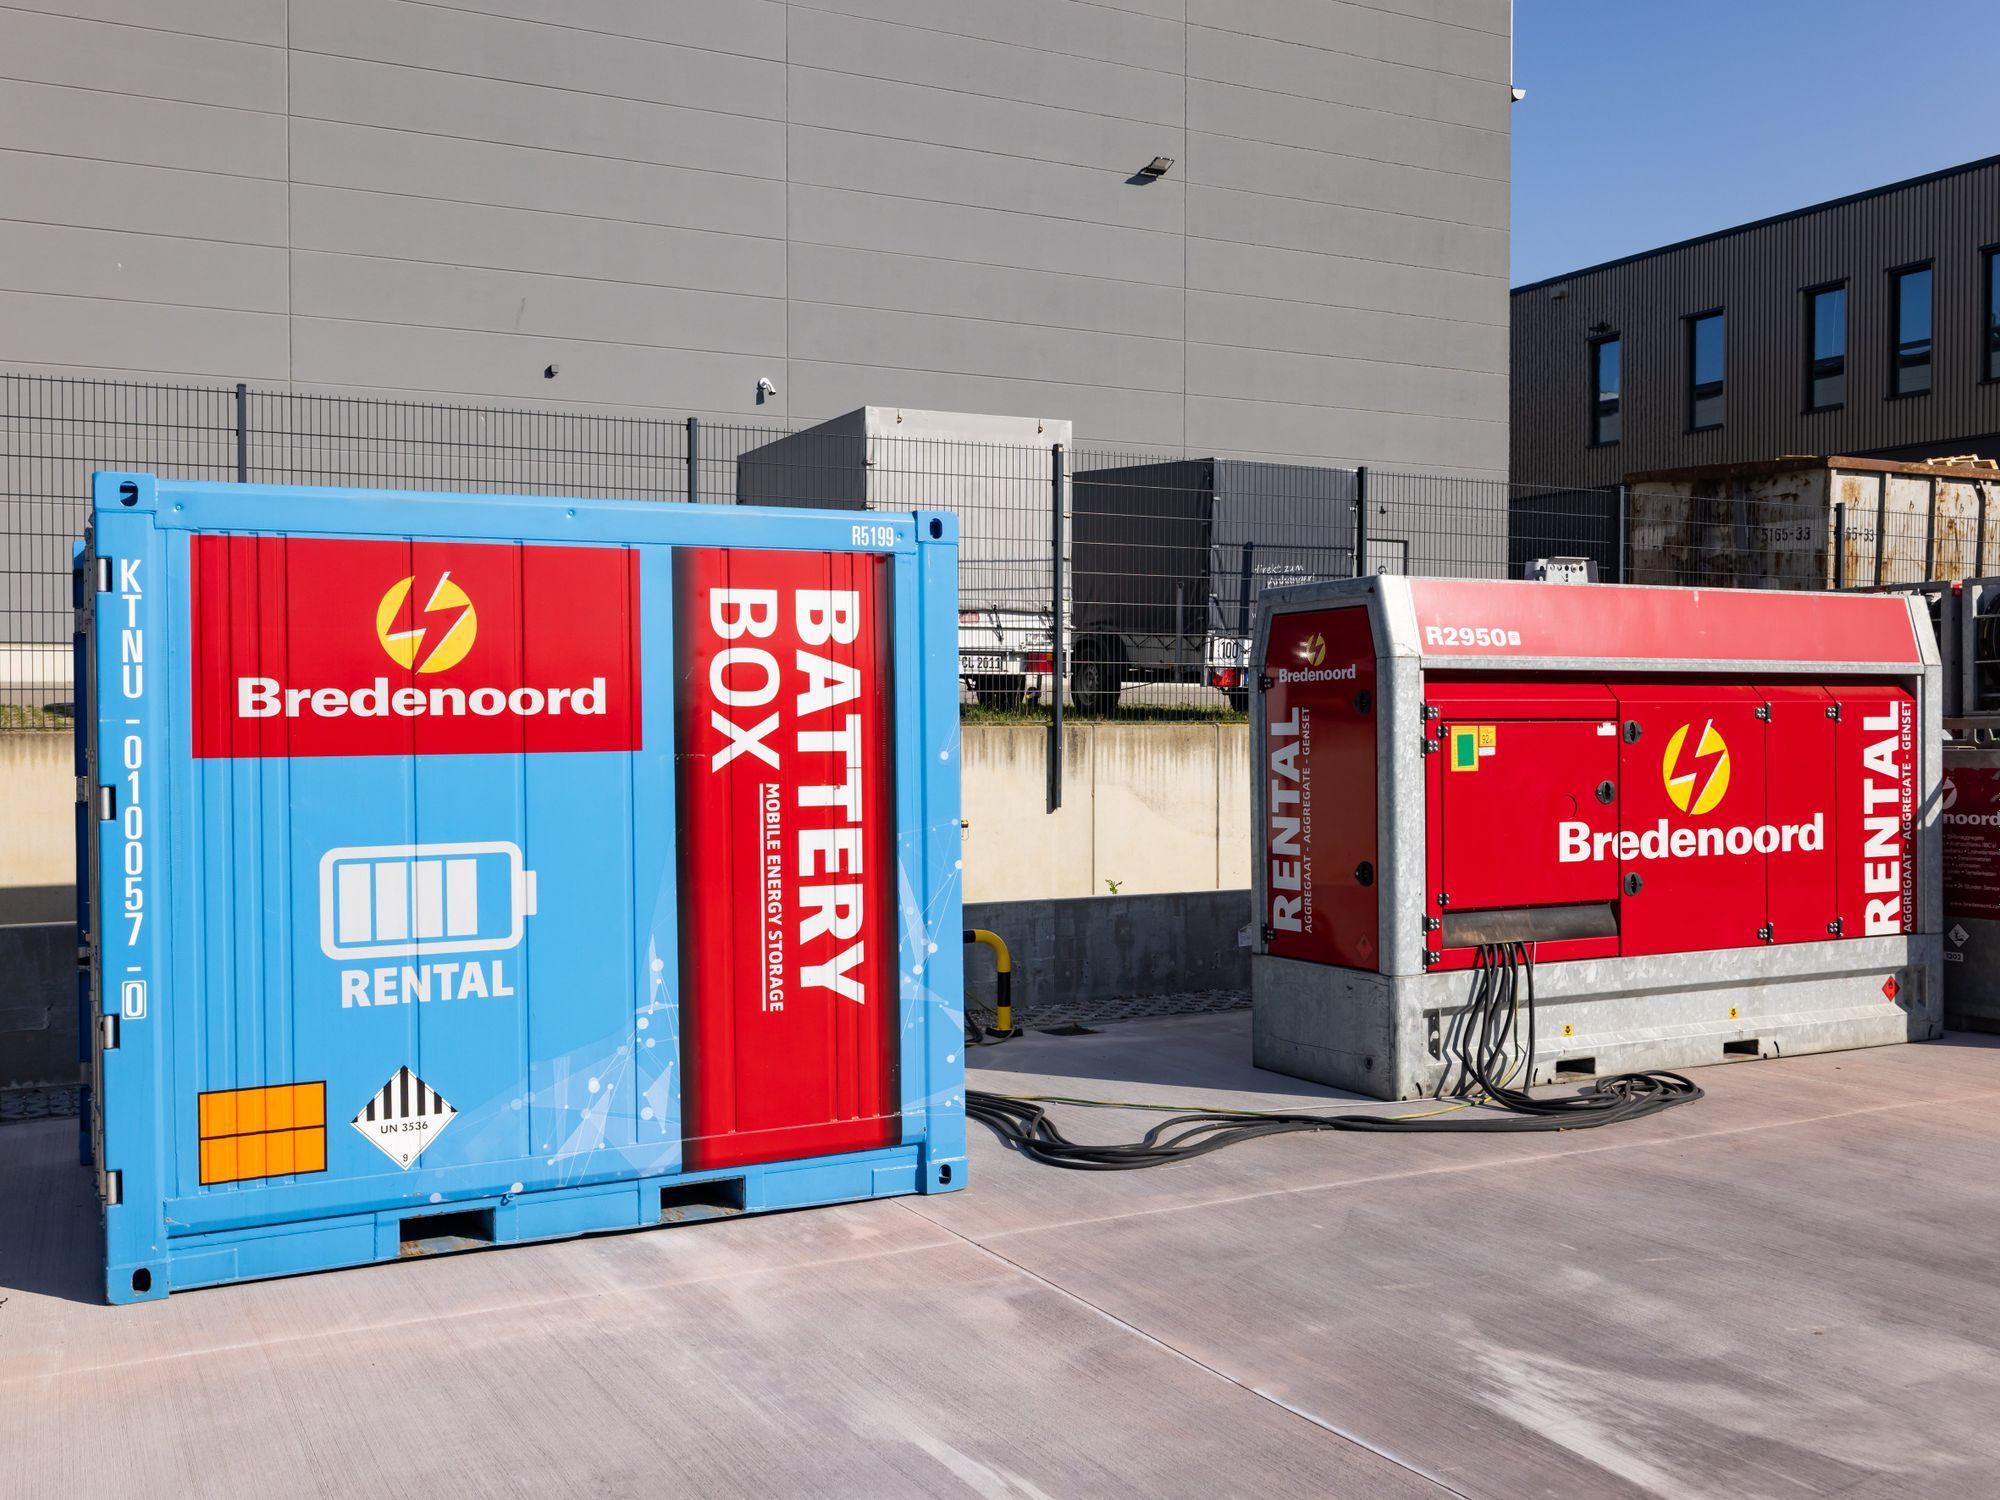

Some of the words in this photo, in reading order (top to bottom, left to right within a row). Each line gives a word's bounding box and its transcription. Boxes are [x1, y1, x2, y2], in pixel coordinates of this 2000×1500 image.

[852, 525, 894, 547] R5199
[1221, 641, 1239, 659] 100
[1425, 626, 1507, 647] R2950
[237, 677, 607, 718] Bredenoord
[709, 587, 781, 774] BOX
[1279, 664, 1356, 683] Bredenoord
[1301, 706, 1310, 756] GENSET
[1902, 701, 1912, 750] GENSET
[765, 783, 781, 850] MOBILE
[795, 589, 865, 1006] BATTERY
[1270, 706, 1302, 933] RENTAL
[1302, 767, 1312, 844] AGGREGATE
[1863, 700, 1900, 937] RENTAL
[1902, 763, 1912, 841] AGGREGATE
[1558, 812, 1824, 863] Bredenoord
[767, 855, 783, 926] ENERGY
[1303, 855, 1313, 934] AGGREGAAT
[1902, 854, 1912, 933] AGGREGAAT
[341, 960, 514, 1009] RENTAL
[768, 930, 784, 1012] STORAGE
[380, 1124, 398, 1134] UN
[402, 1121, 428, 1132] 3536
[402, 1153, 409, 1162] 9
